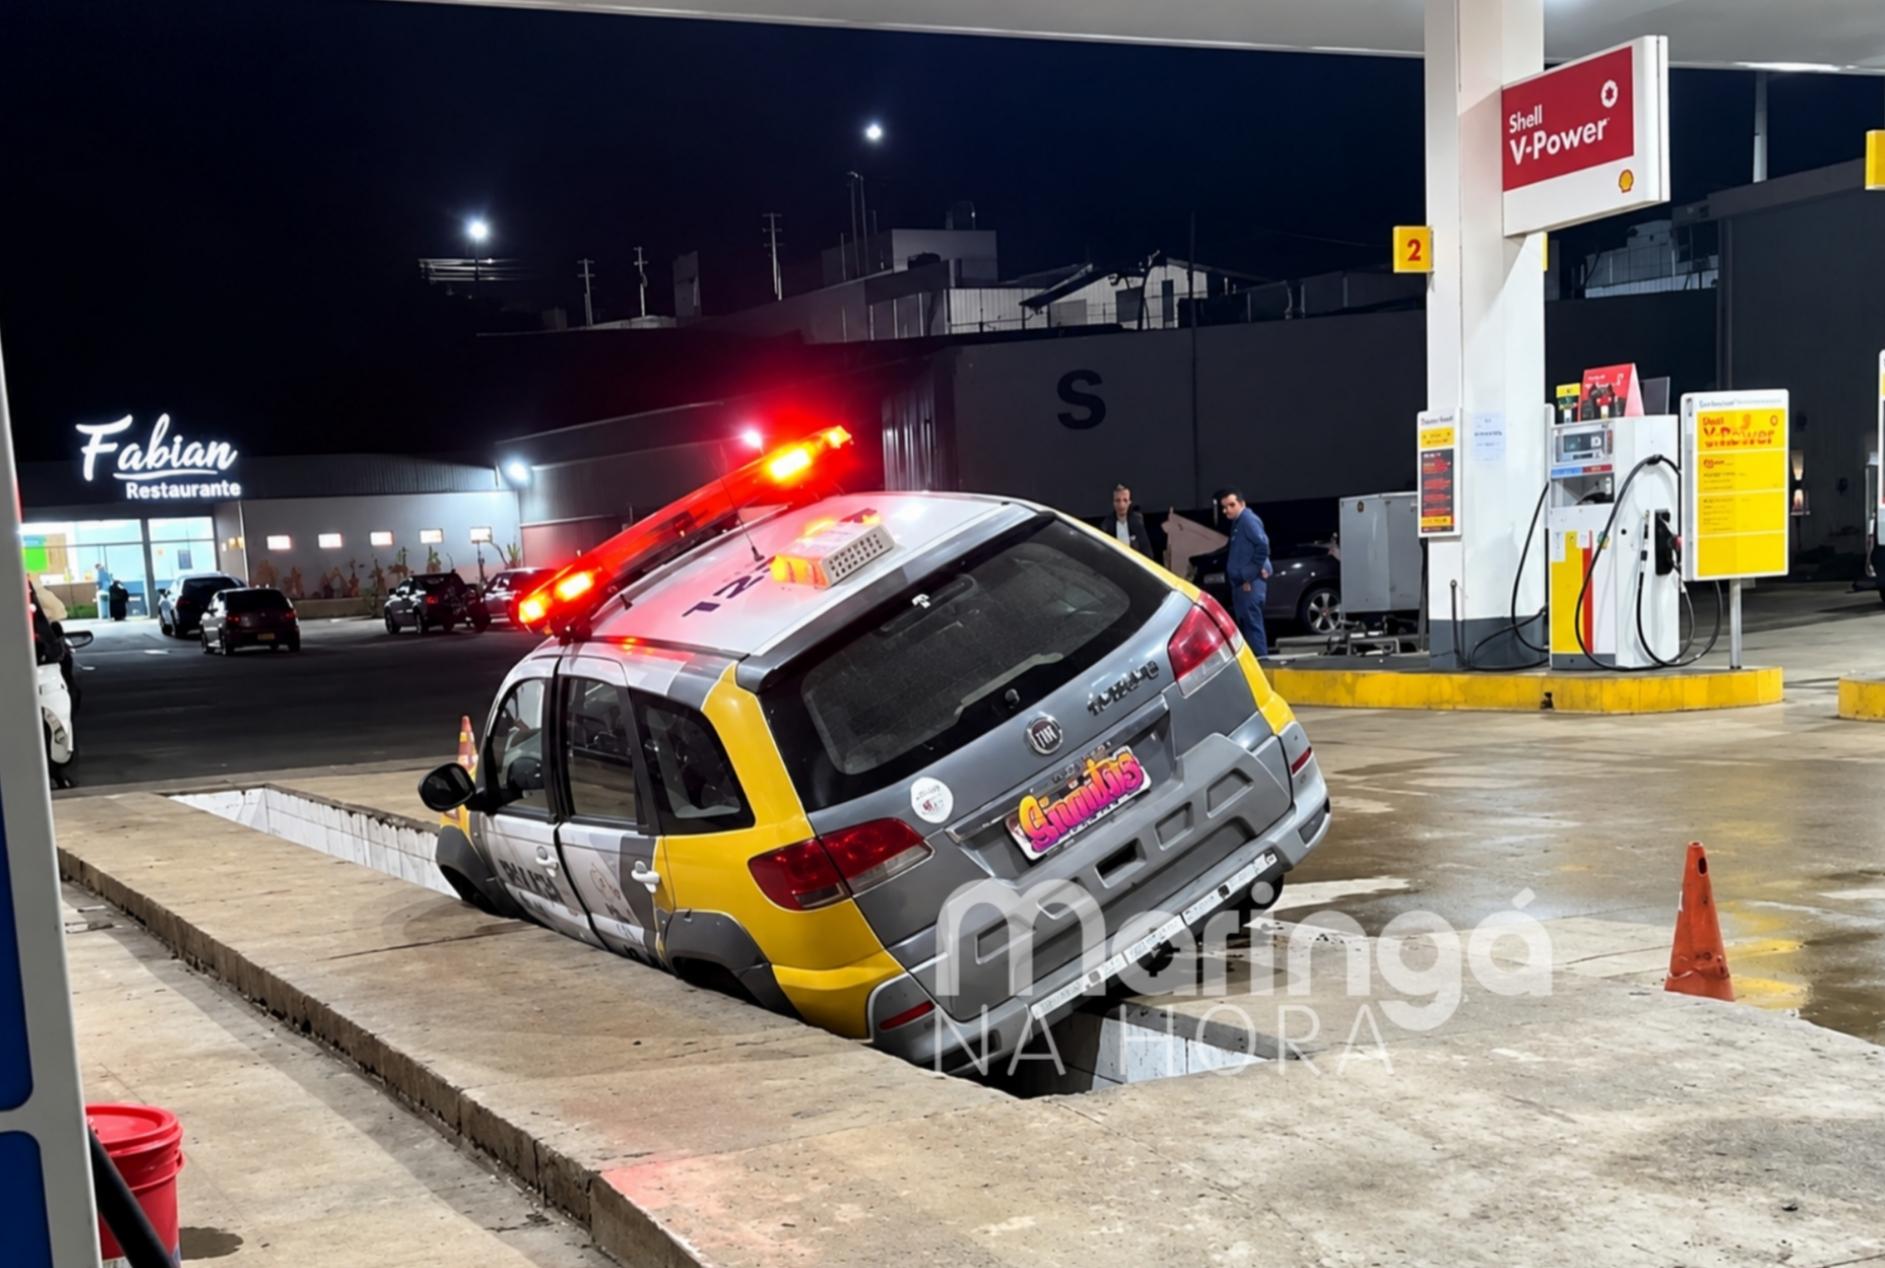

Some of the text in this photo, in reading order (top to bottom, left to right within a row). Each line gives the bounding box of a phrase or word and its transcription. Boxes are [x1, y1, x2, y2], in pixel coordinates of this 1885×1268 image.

[1509, 104, 1543, 133] Shell
[1510, 117, 1609, 165] V-Power
[1407, 239, 1422, 262] 2
[1057, 369, 1107, 430] S
[75, 413, 238, 482] Fabian
[126, 481, 242, 500] Restaurante
